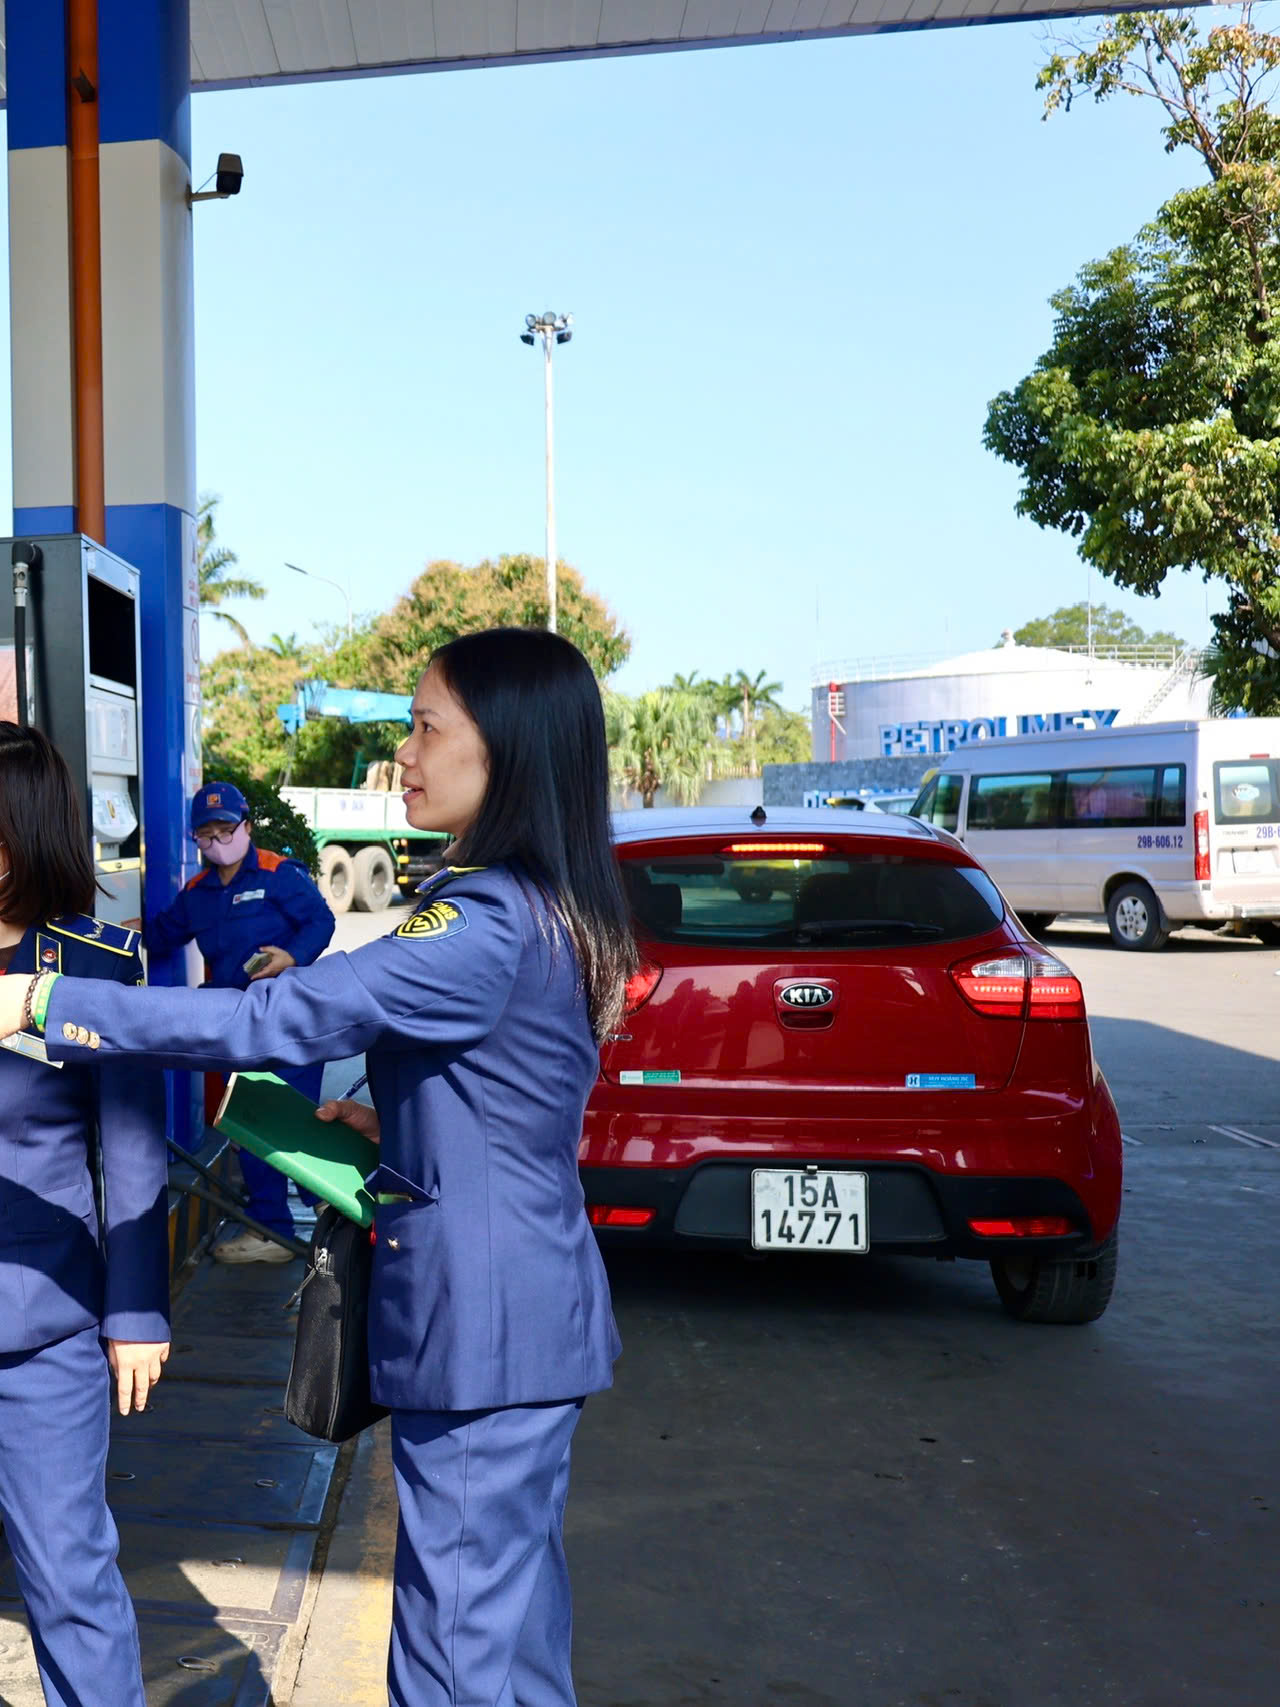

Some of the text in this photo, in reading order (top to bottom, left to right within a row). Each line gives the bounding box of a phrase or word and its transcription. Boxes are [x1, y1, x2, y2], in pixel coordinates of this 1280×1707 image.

[1137, 835, 1183, 848] 29B-606.12
[790, 988, 825, 1003] KIA
[784, 1175, 839, 1209] 15A
[761, 1209, 860, 1247] 147.71
